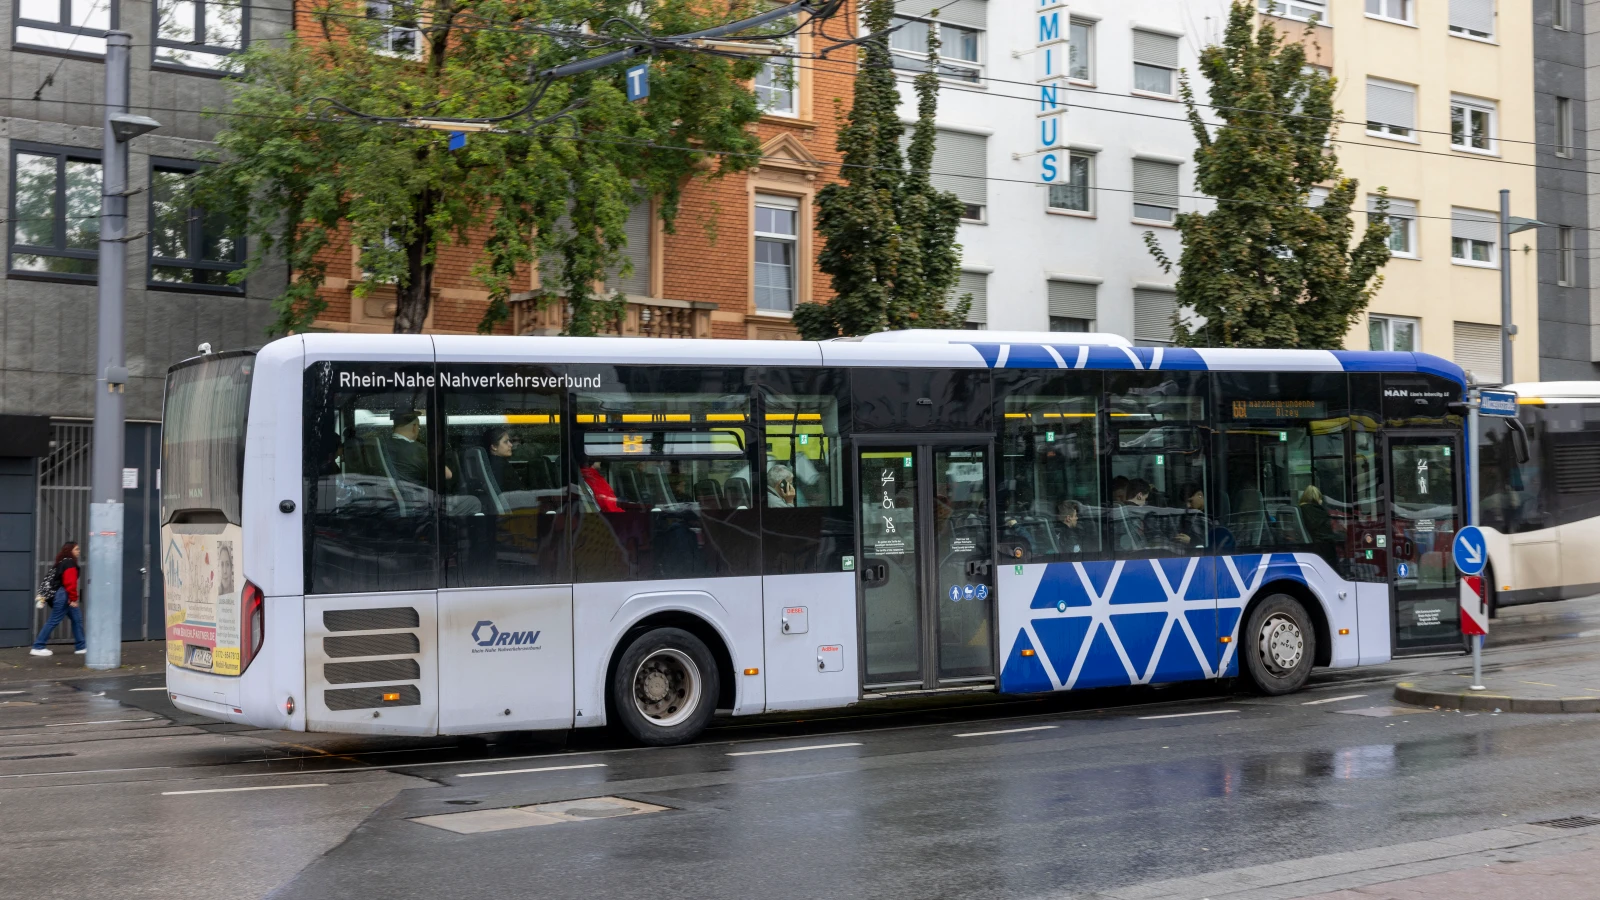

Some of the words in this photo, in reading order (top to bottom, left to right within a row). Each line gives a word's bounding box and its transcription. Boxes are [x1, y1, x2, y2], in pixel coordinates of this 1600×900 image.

[628, 68, 645, 95] T
[1039, 0, 1059, 182] MINUS
[339, 372, 435, 388] Rhein-Nahe
[440, 373, 601, 388] Nahverkehrsverbund
[1384, 389, 1408, 397] MAN
[1276, 408, 1299, 418] Alzey
